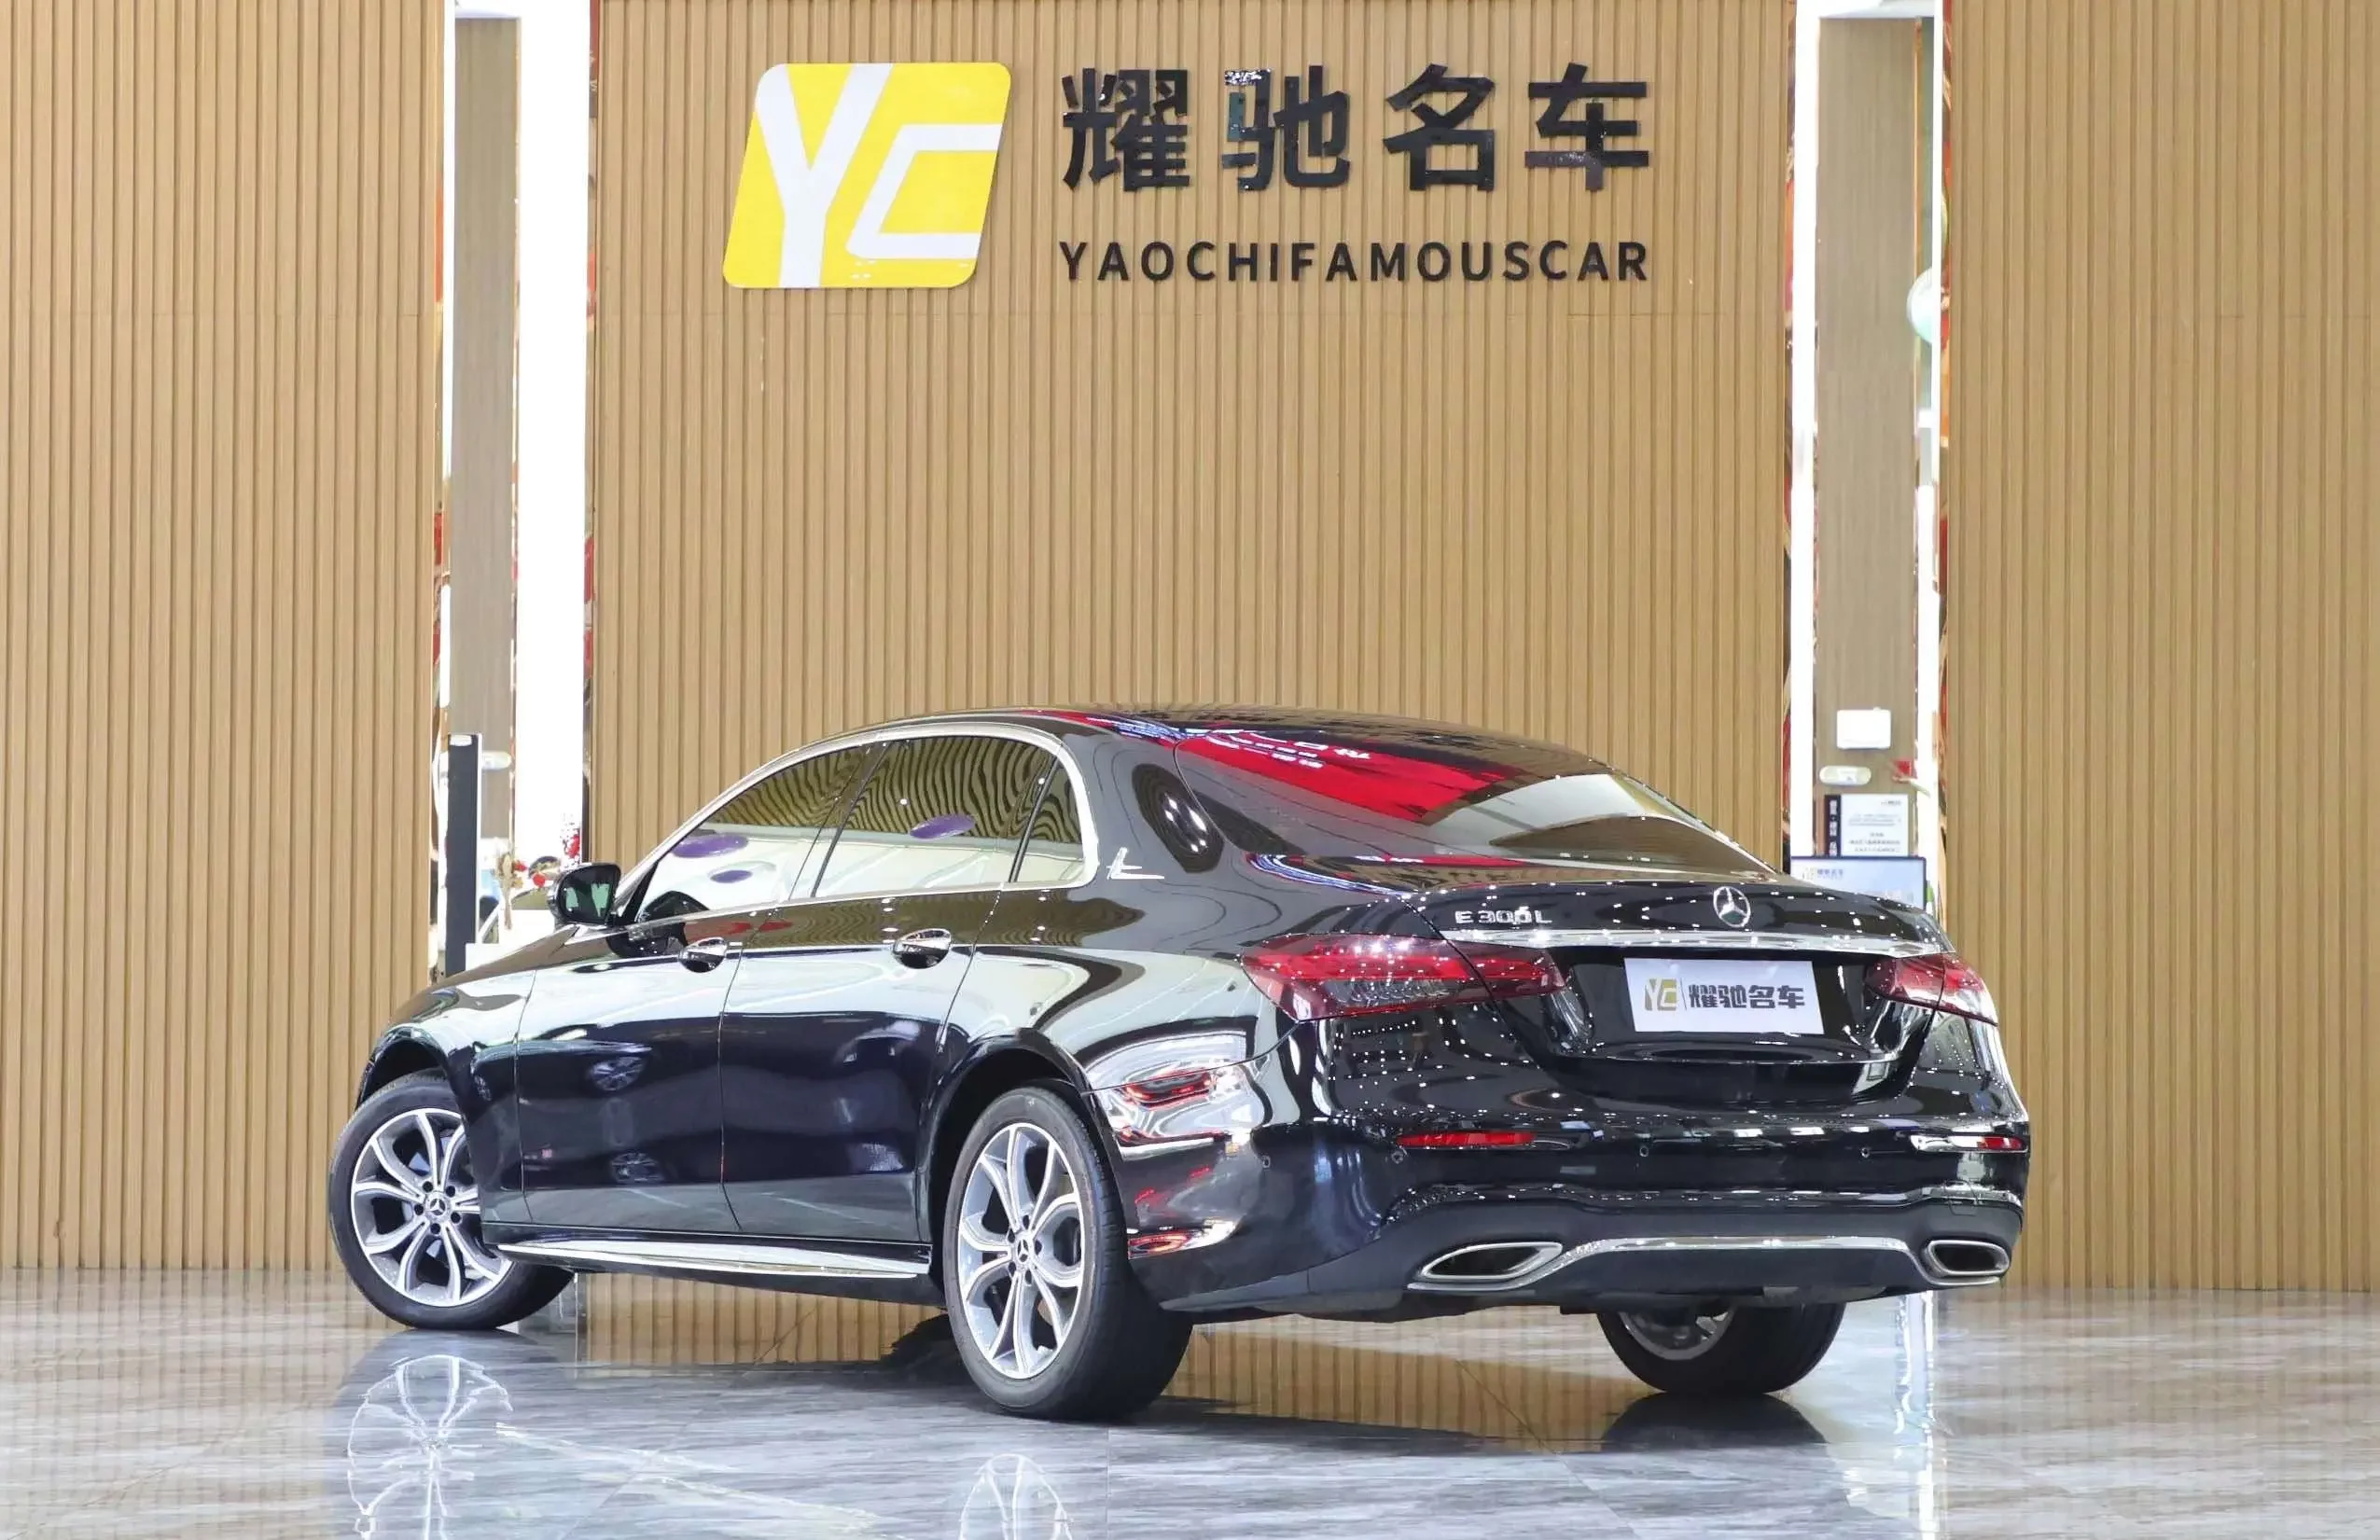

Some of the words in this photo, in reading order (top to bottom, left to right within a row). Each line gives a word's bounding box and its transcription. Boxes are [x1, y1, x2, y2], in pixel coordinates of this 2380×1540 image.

[1062, 62, 1650, 192] 耀驰名车
[751, 62, 1004, 288] YC
[1060, 241, 1649, 282] YAOCHIFAMOUSCAR
[1689, 984, 1805, 1009] 耀驰名车
